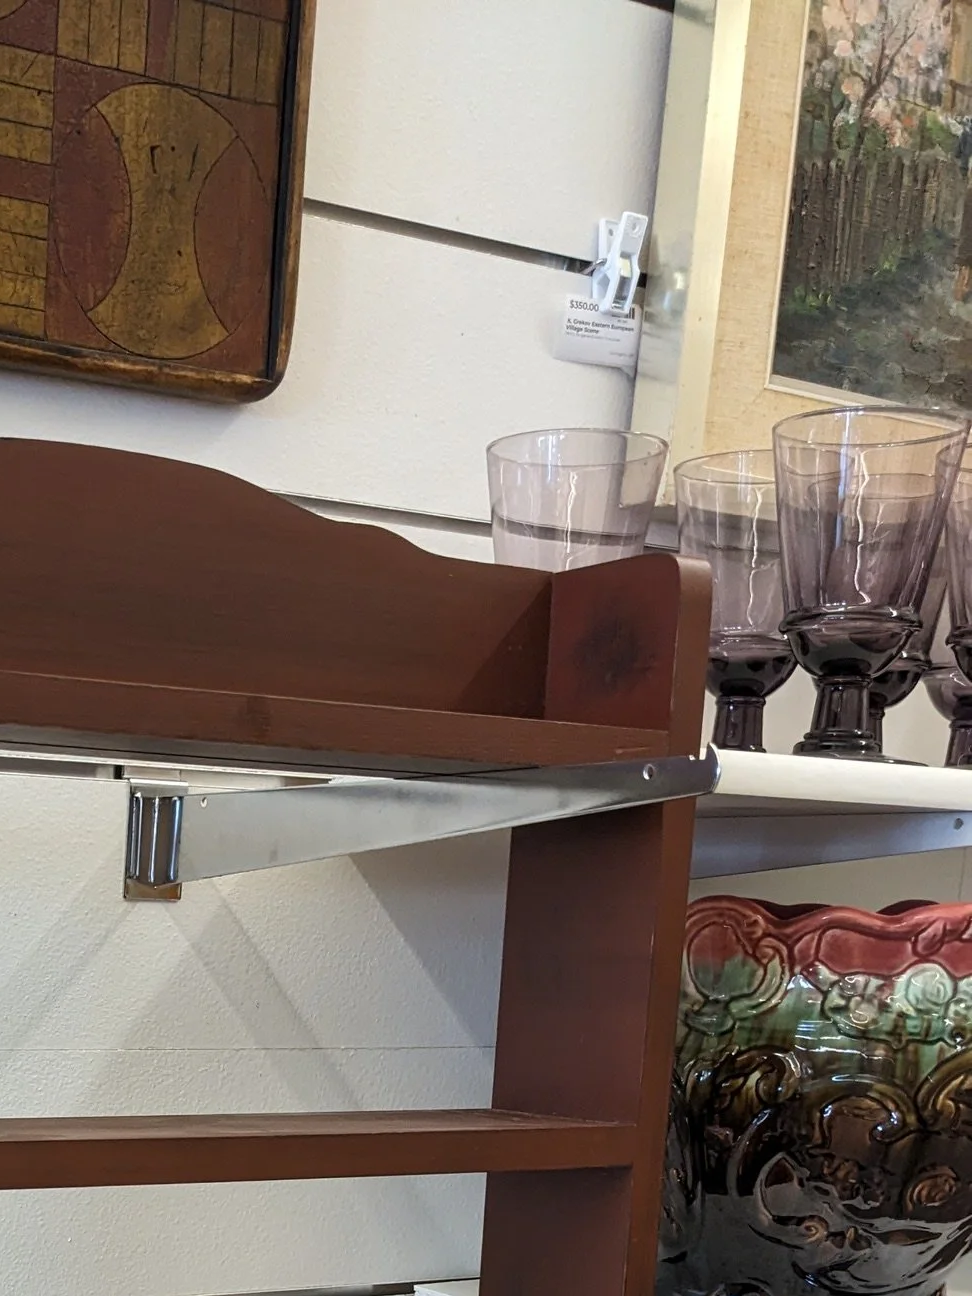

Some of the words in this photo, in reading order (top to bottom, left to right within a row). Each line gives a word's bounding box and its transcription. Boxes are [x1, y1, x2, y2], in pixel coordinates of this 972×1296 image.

[570, 299, 599, 312] $350.00
[566, 324, 583, 333] Village
[591, 321, 611, 329] Eastern
